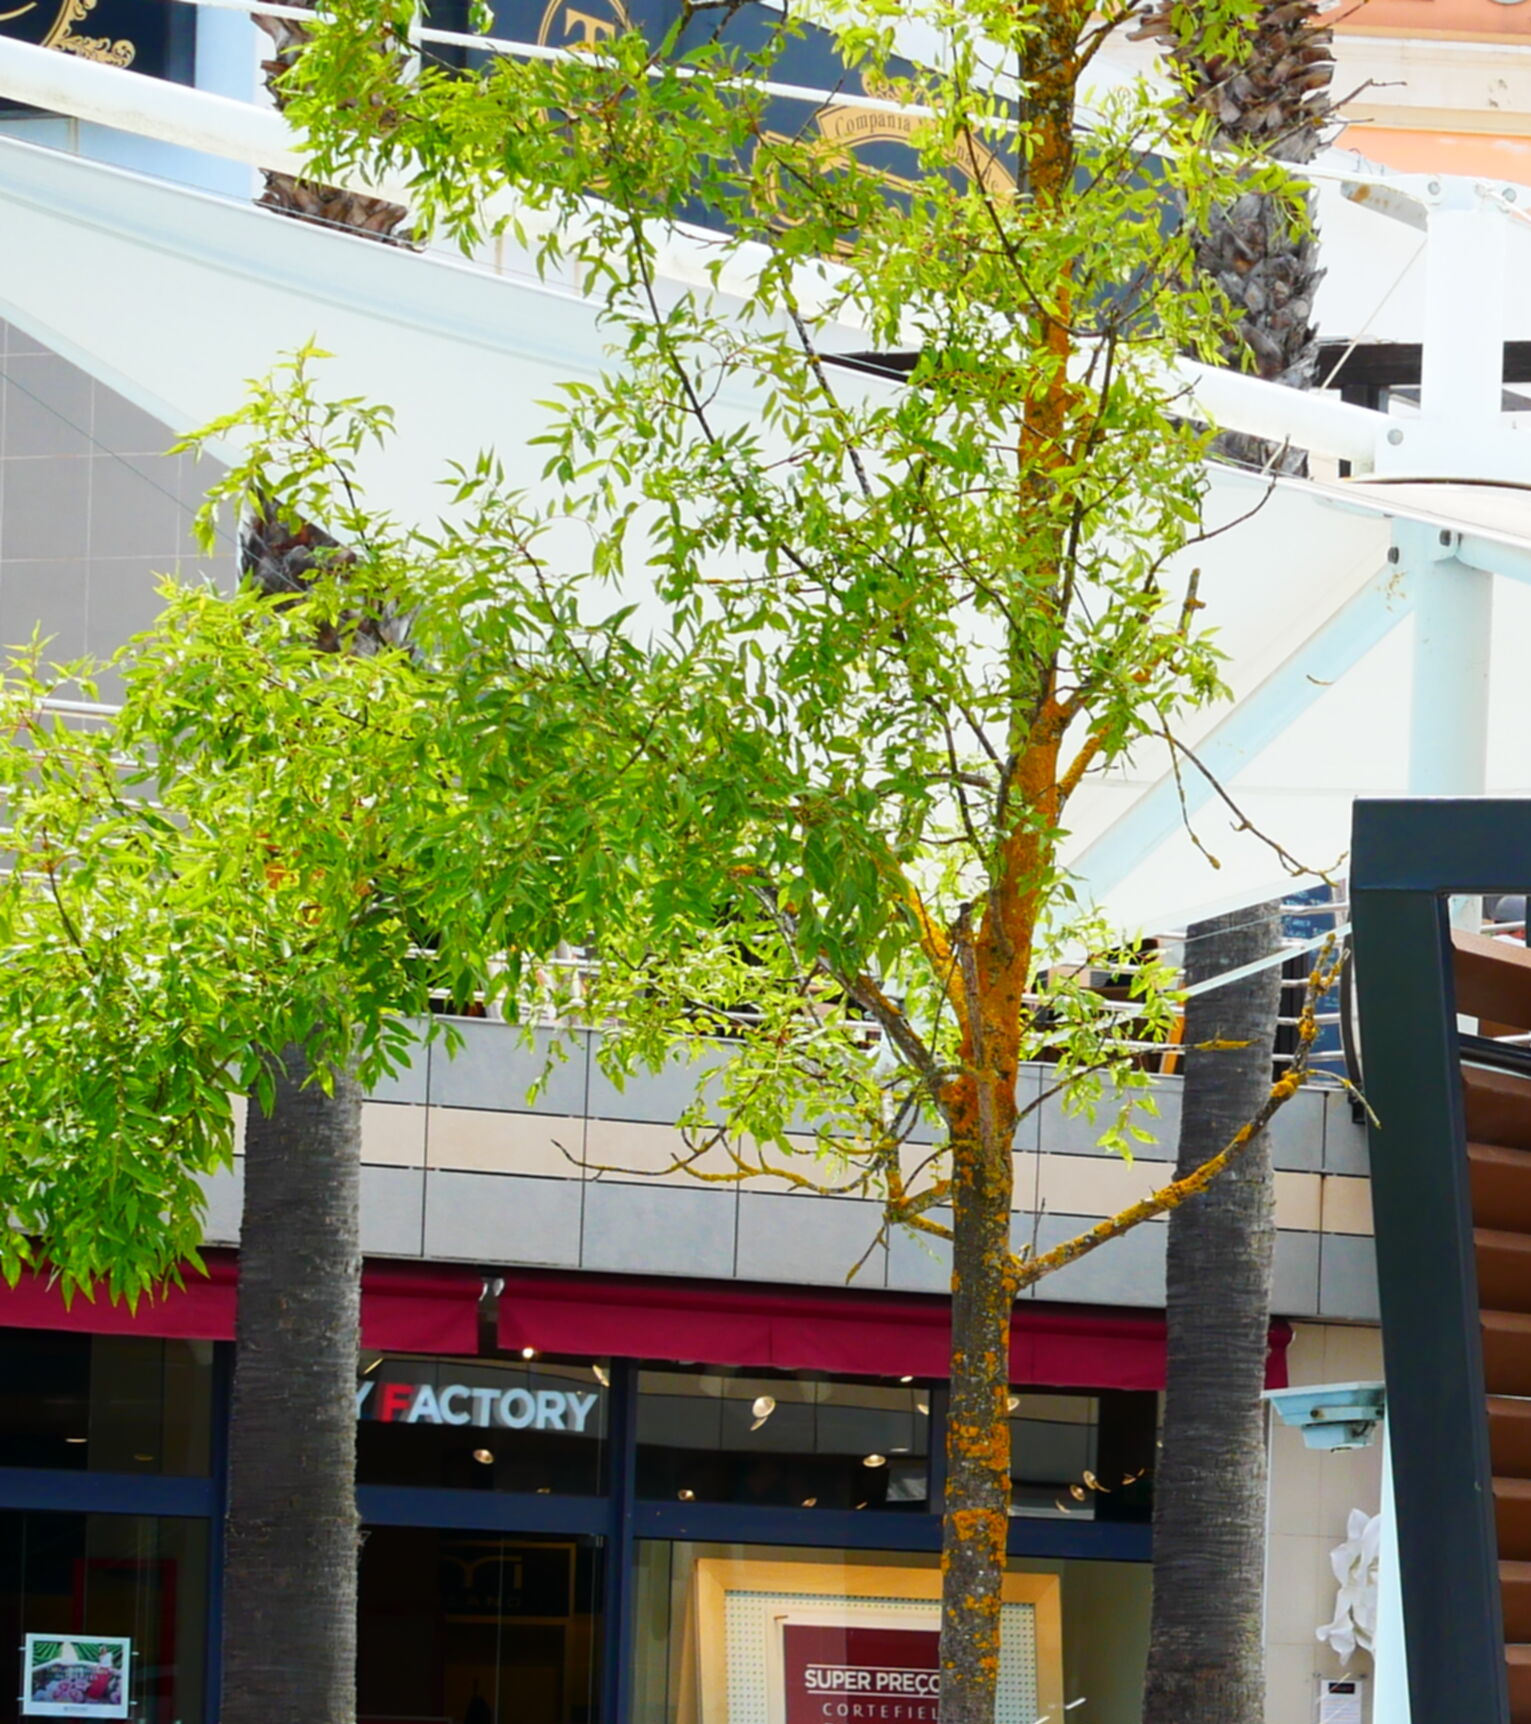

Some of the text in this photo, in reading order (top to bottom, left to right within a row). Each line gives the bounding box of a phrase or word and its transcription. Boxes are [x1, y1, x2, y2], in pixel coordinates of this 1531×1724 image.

[380, 1382, 598, 1432] FACTORY
[804, 1669, 871, 1690] SUPER
[822, 1702, 938, 1720] CORTEFIEL
